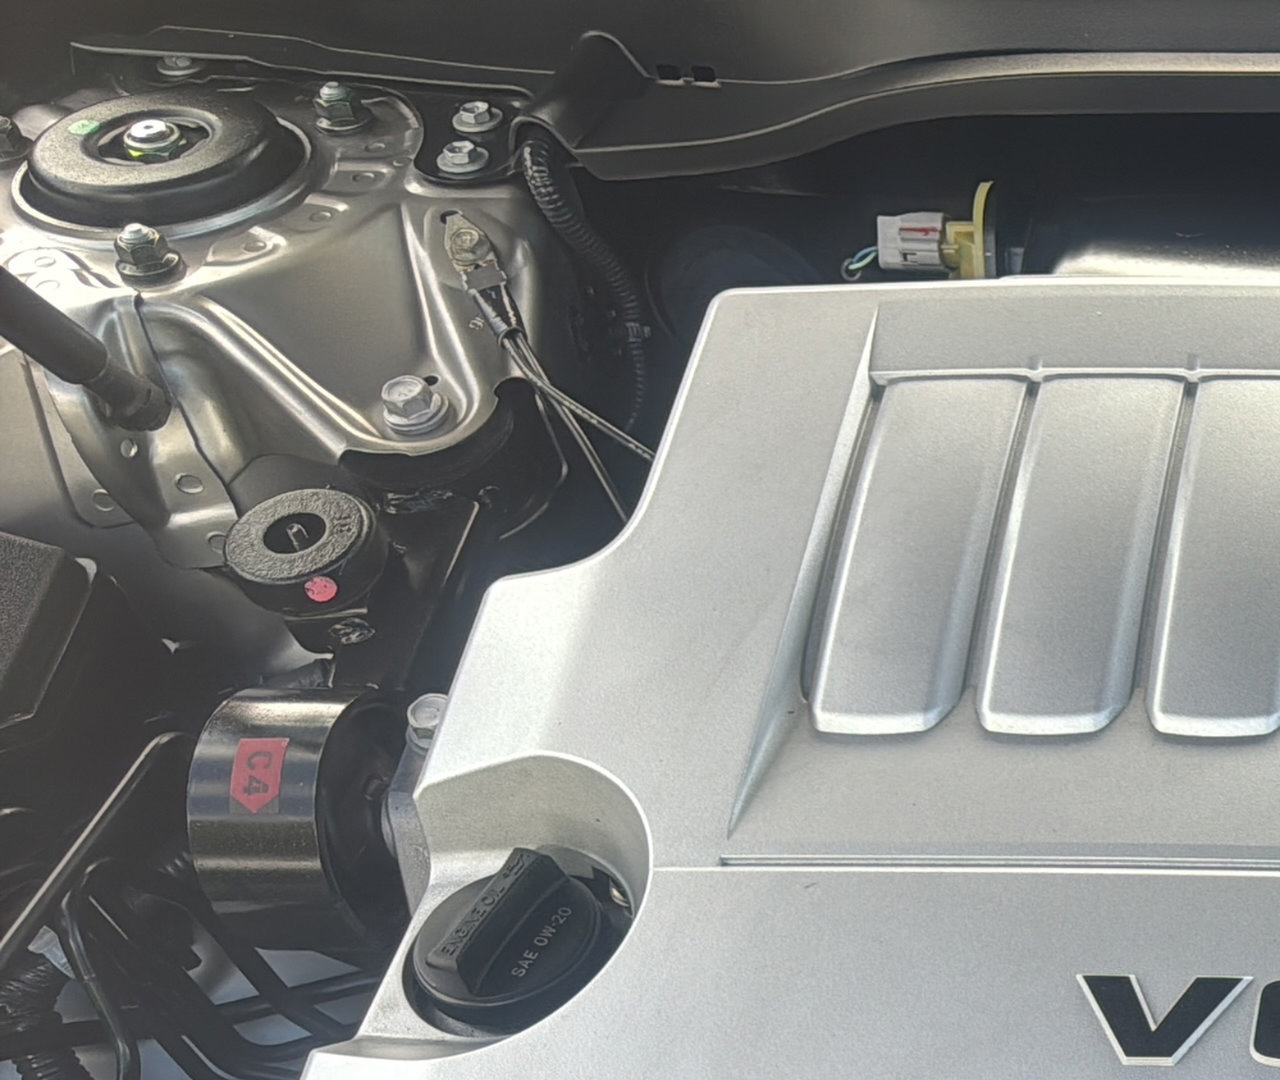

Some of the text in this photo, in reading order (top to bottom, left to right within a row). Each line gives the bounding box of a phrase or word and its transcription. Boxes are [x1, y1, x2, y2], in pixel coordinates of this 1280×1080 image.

[243, 750, 273, 796] C4
[440, 905, 488, 957] ENGINE
[511, 906, 573, 977] SAE 0W-20
